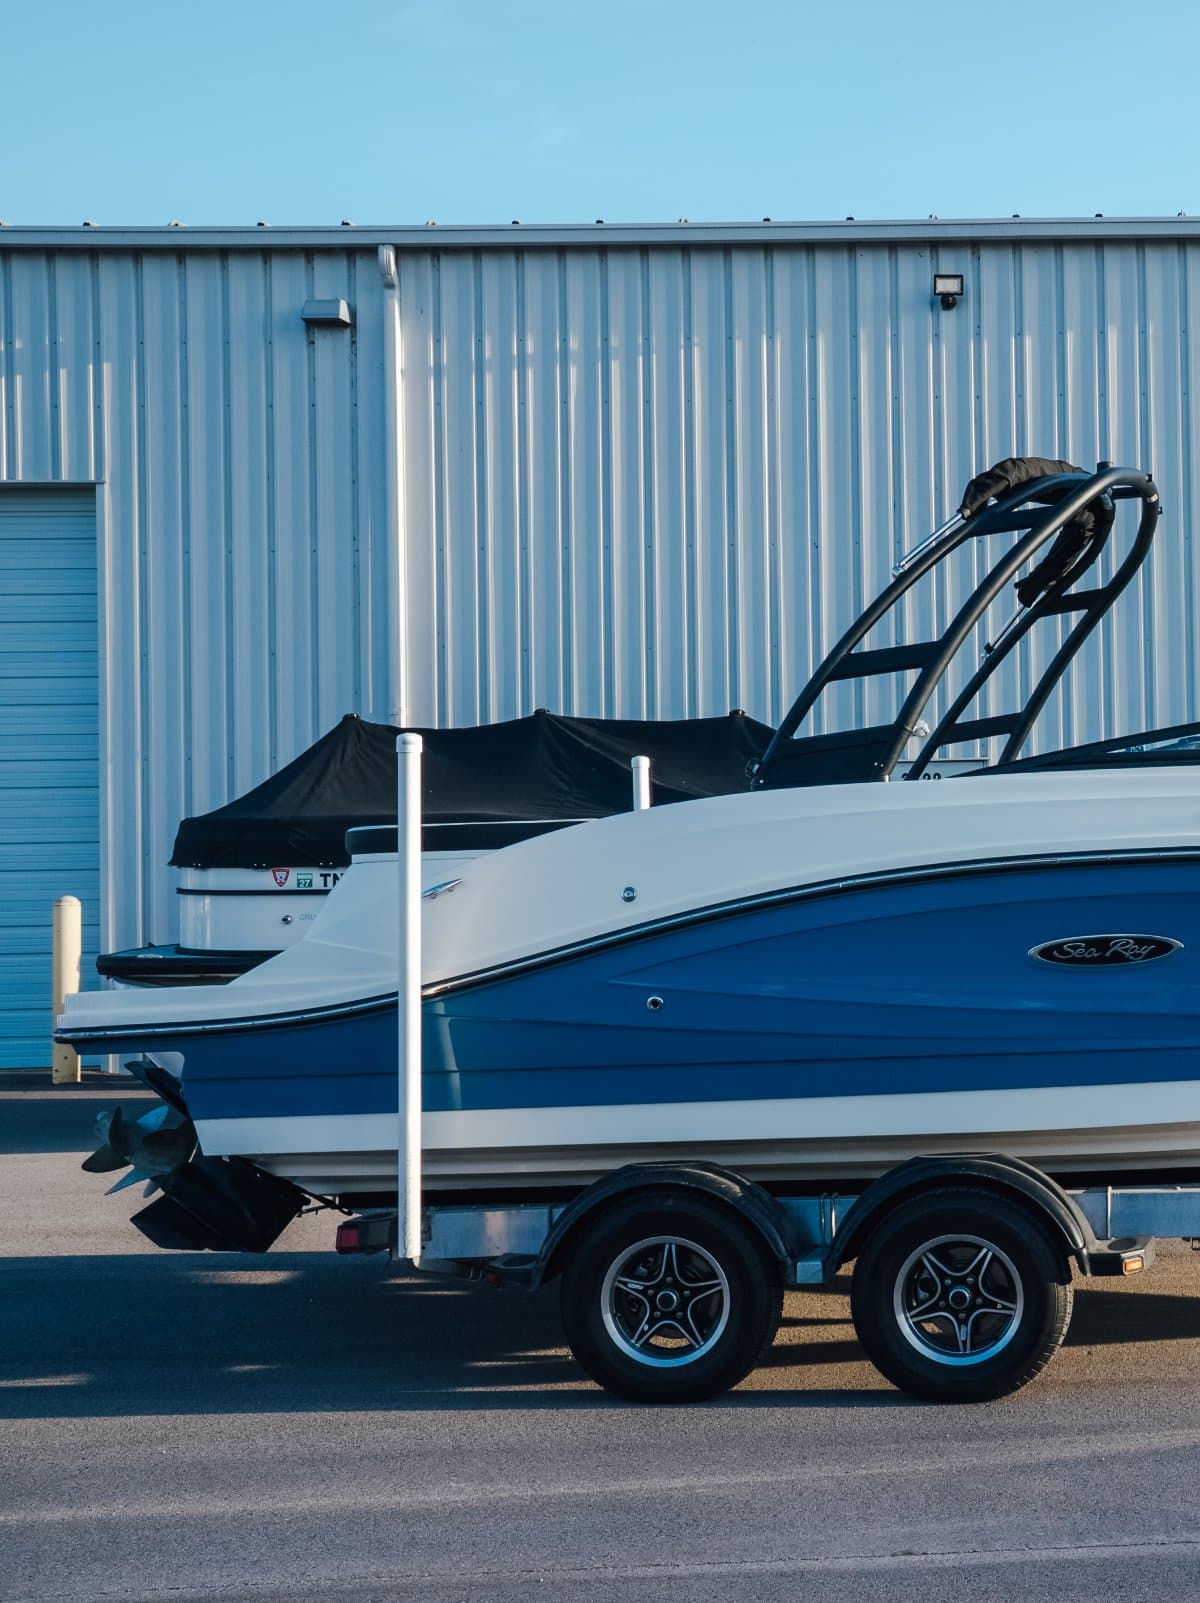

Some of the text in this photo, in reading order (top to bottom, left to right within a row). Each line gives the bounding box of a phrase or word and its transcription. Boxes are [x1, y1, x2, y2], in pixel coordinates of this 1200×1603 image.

[299, 879, 310, 888] 27
[1053, 938, 1156, 960] Sea Ray
